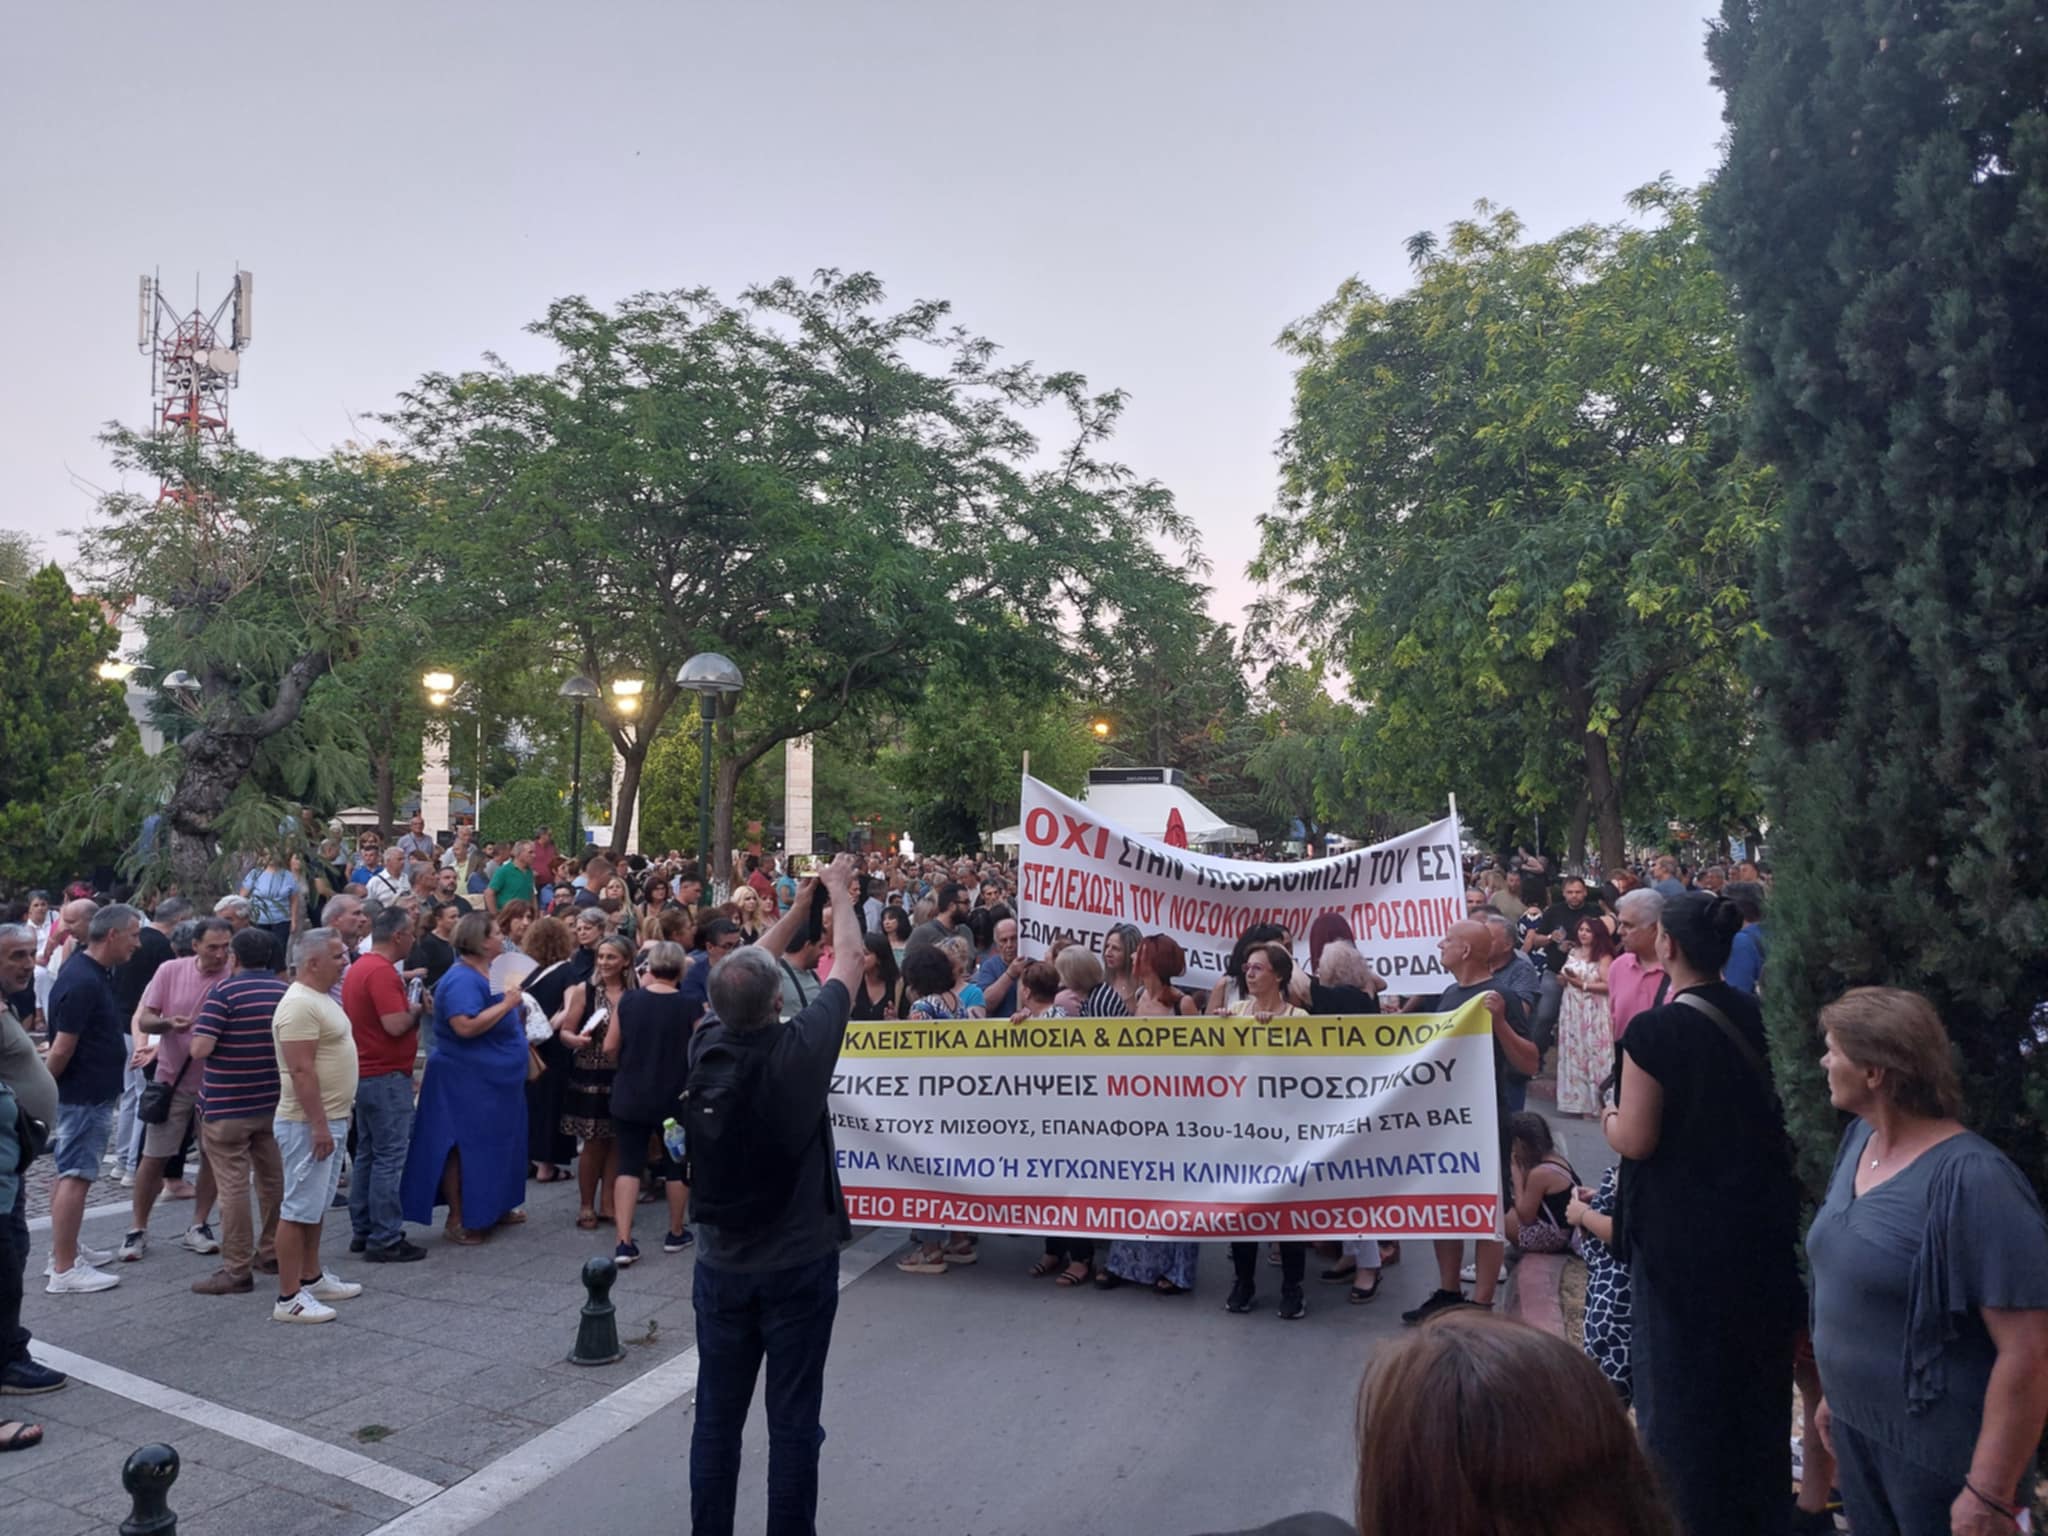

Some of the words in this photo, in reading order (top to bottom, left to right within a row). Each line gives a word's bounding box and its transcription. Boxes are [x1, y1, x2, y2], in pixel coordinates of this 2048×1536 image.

[1025, 807, 1110, 860] ΟΧΙ
[1118, 836, 1184, 881] ΣΤΗΝ
[1369, 848, 1410, 886] ΤΟΥ
[1023, 862, 1125, 918] ΣΤΕΛΕΧΩΣΗ
[1129, 884, 1166, 926] ΤΟΥ
[1020, 918, 1104, 953] ΣΩΜΑΤΕ
[845, 1029, 968, 1050] ΚΛΕΙΣΤΙΚΑ
[975, 1028, 1086, 1048] ΔΗΜΟΣΙΑ
[1094, 1027, 1110, 1047] &
[1117, 1027, 1225, 1047] ΔΩΡΕΑΝ
[1233, 1026, 1312, 1047] ΥΓΕΙΑ
[1321, 1025, 1366, 1048] ΓΙΑ
[1375, 1013, 1456, 1048] ΟΛΟΥΣ
[830, 1075, 909, 1096] ΖΙΚΕΣ
[919, 1075, 1098, 1097] ΠΡΟΣΛΗΨΕΙΣ
[1107, 1075, 1247, 1097] ΜΟΝΙΜΟΥ
[1258, 1059, 1456, 1099] ΠΡΟΣΩΠΙΚΟΥ
[828, 1112, 870, 1132] ΗΣΕΙΣ
[875, 1118, 934, 1134] ΣΤΟΥΣ
[940, 1119, 1036, 1137] ΜΙΣΘΟΥΣ,
[1042, 1119, 1169, 1137] ΕΠΑΝΑΦΟΡΑ
[1176, 1121, 1290, 1143] 13ου-14ου,
[1298, 1116, 1372, 1140] ΕΝΤΑΞΗ
[1378, 1112, 1421, 1131] ΣΤΑ
[1427, 1107, 1473, 1127] ΒΑΕ
[835, 1150, 880, 1169] ΕΝΑ
[887, 1154, 995, 1177] ΚΛΕΙΣΙΜΟ
[1027, 1158, 1175, 1182] ΣΥΓΧΩΝΕΥΣΗ
[844, 1195, 895, 1216] ΤΕΙΟ
[902, 1197, 1078, 1226] ΕΡΓΑΖΟΜΕΝΩΝ
[1086, 1207, 1281, 1232] ΜΠΟΔΟΣΑΚΕΙΟΥ
[1291, 1204, 1496, 1230] ΝΟΣΟΚΟΜΕΙΟΥ
